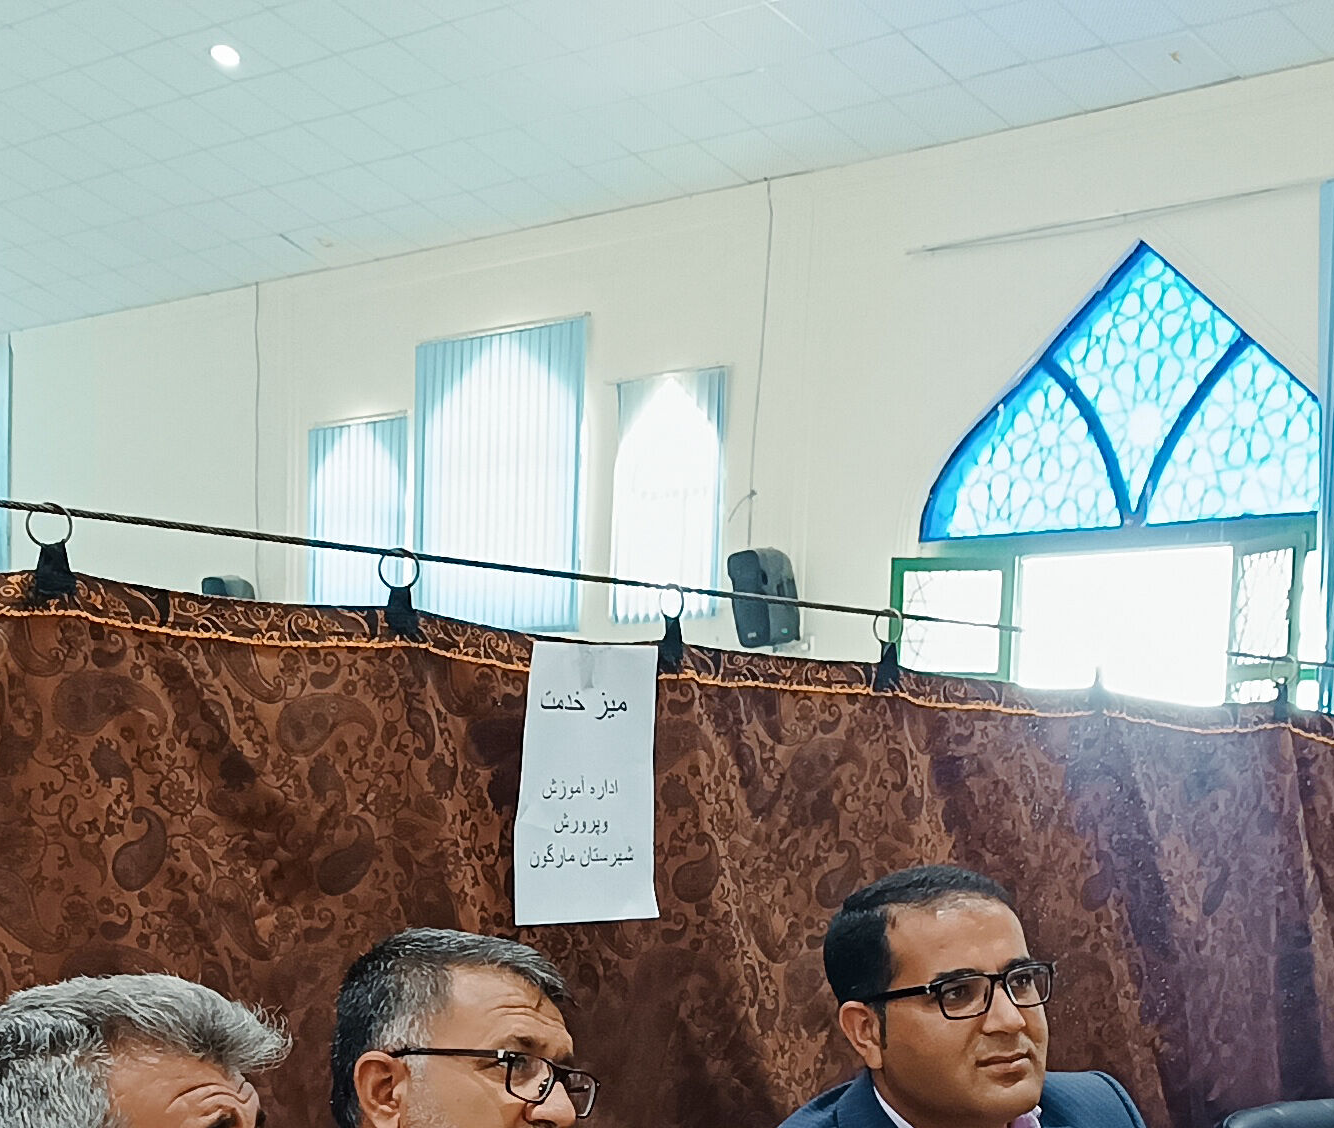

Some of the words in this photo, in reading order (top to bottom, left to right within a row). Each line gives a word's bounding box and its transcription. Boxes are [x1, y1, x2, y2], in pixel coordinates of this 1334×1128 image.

[540, 690, 585, 712] خدمت
[595, 691, 628, 720] میز
[589, 779, 619, 799] اداره
[529, 843, 576, 869] مارگون
[579, 846, 634, 869] شهرستان
